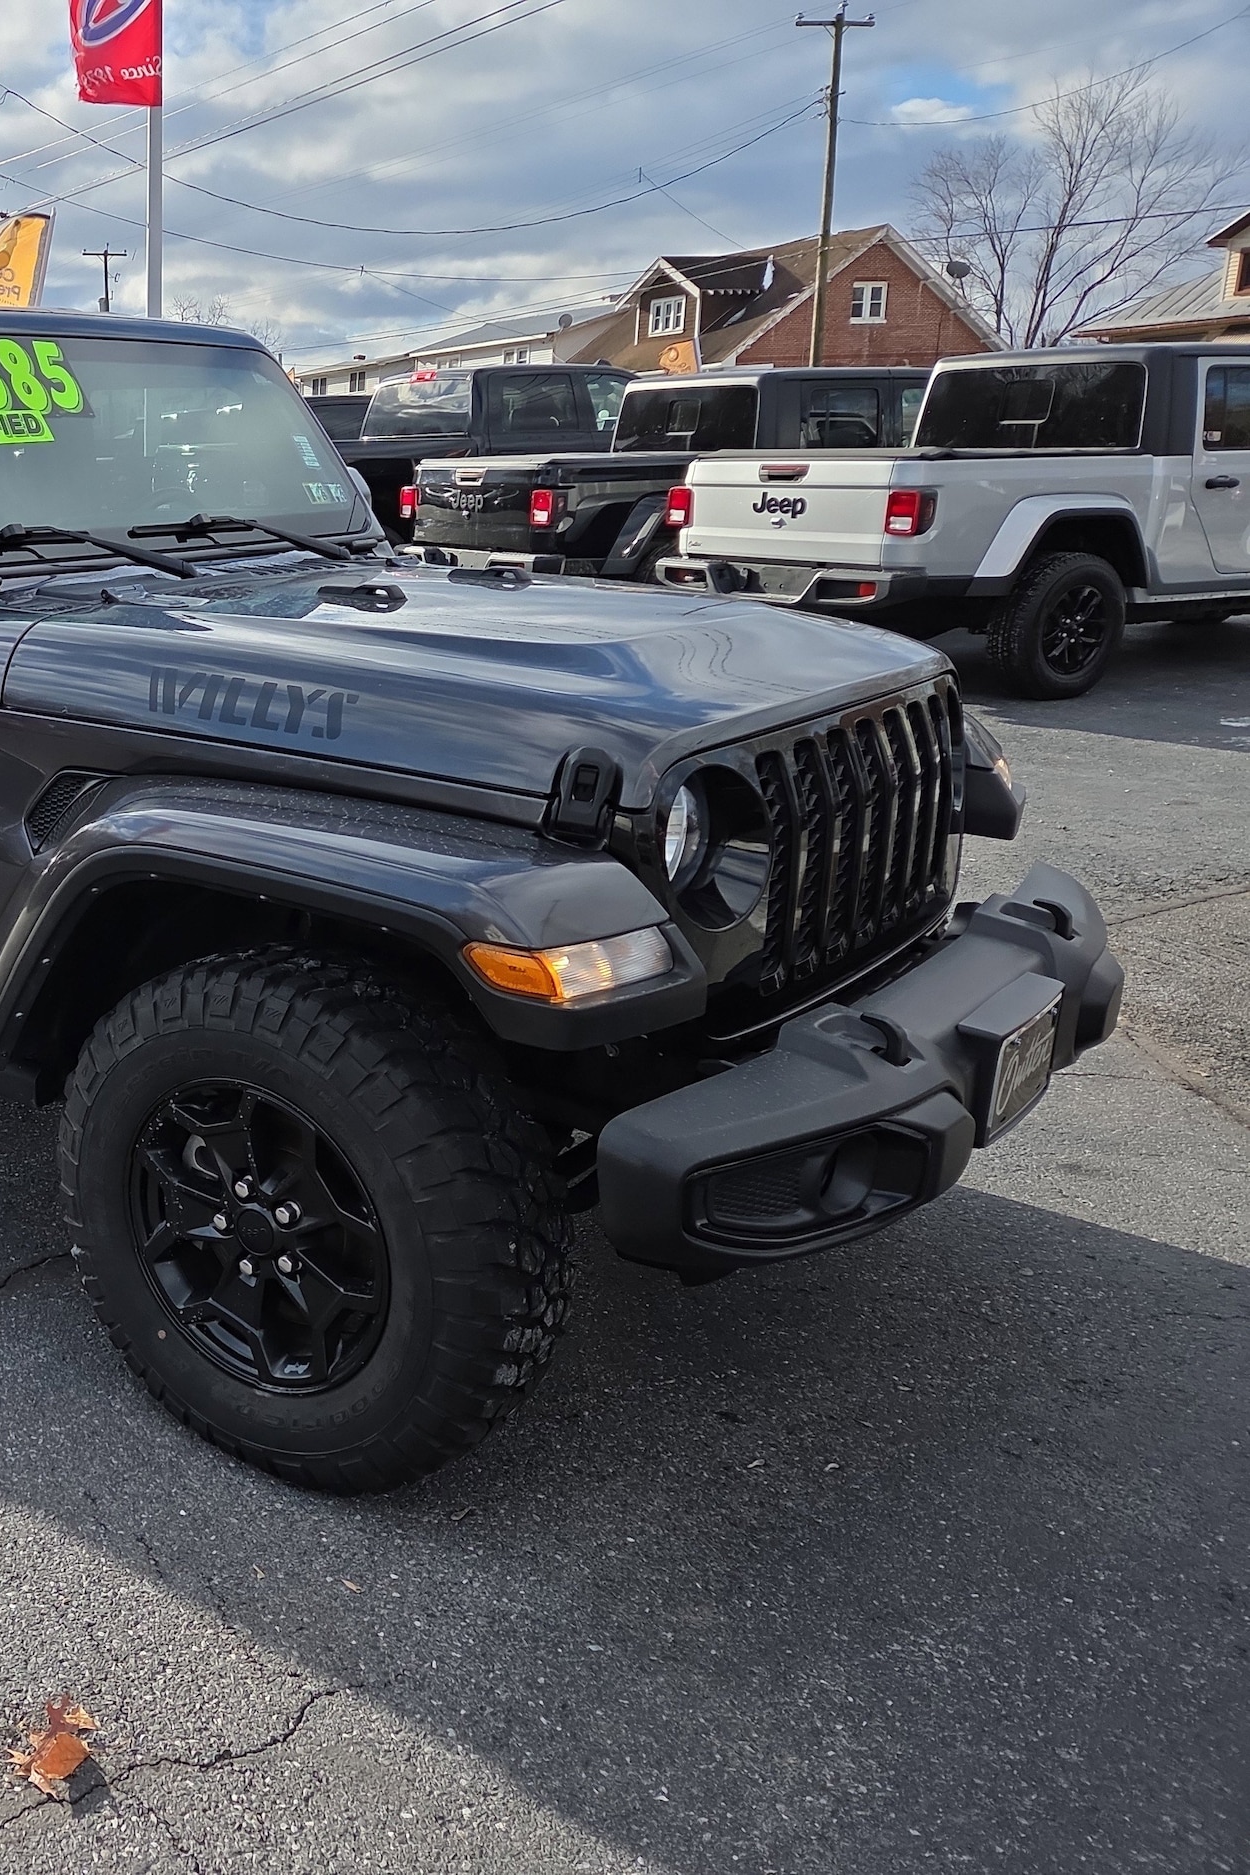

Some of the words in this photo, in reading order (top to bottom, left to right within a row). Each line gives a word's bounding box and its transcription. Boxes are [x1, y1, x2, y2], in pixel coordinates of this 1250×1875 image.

[450, 490, 484, 513] Jeep
[752, 492, 808, 519] Jeep
[149, 667, 360, 740] WILLYS
